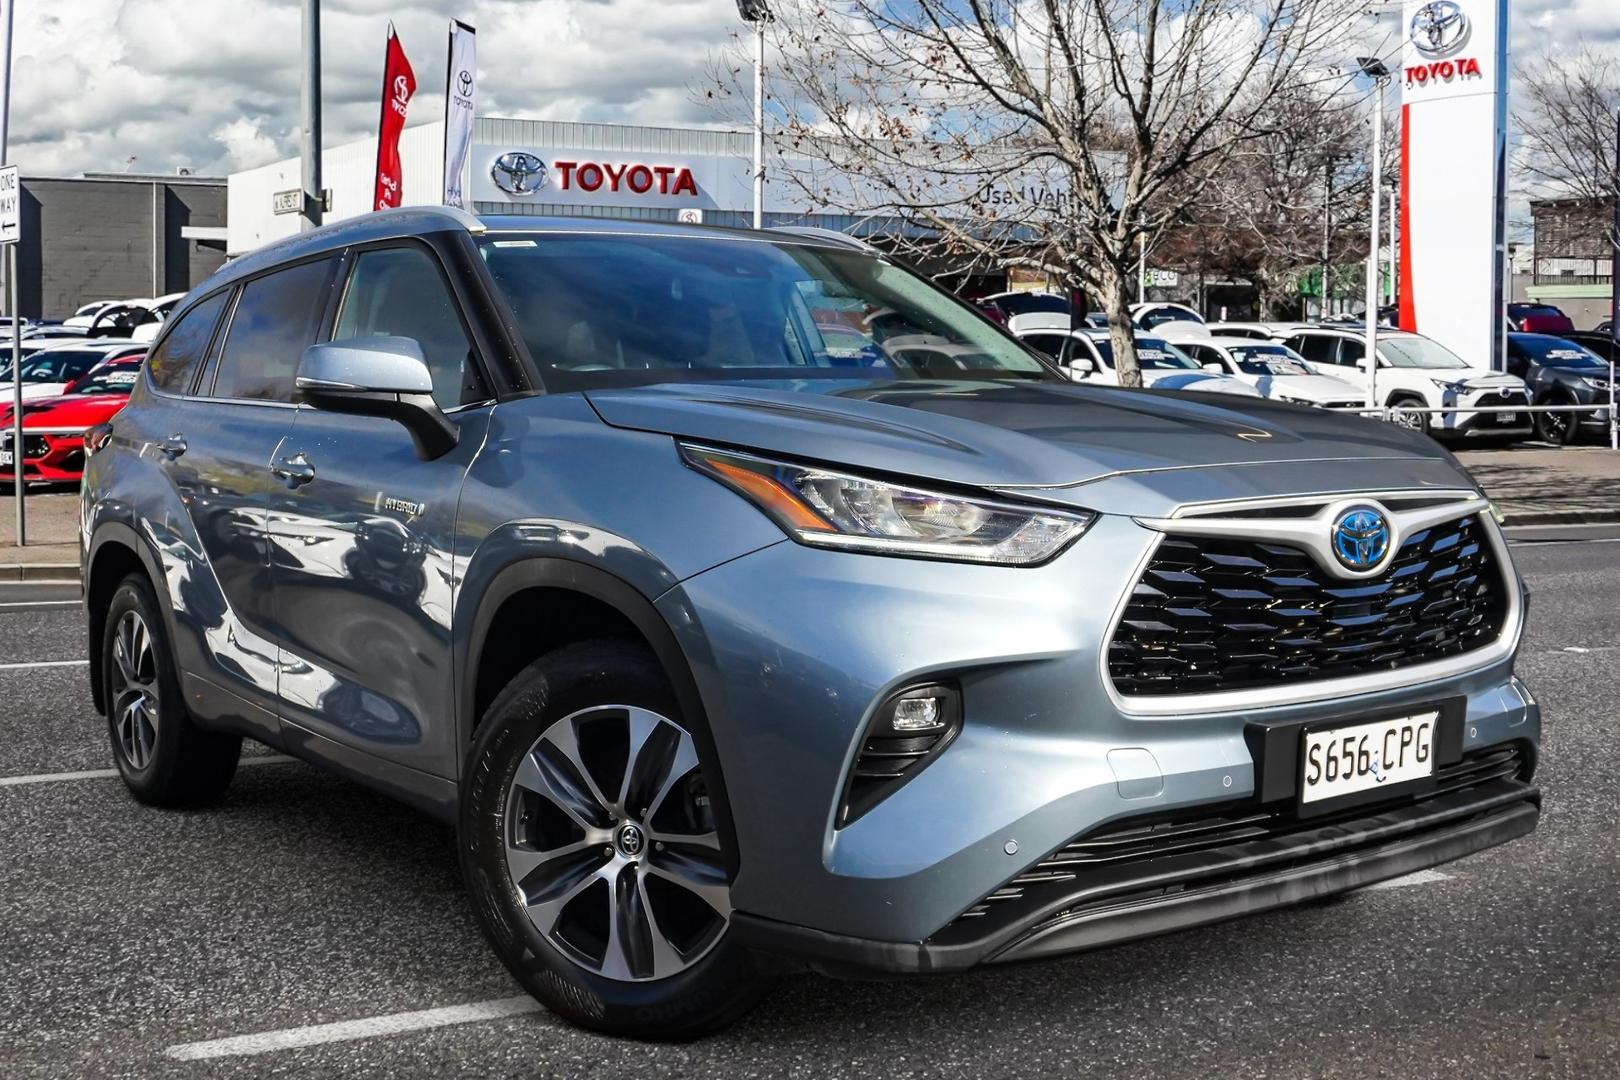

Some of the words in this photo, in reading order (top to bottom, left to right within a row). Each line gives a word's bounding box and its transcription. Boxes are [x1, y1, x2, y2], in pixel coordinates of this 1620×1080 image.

[1404, 58, 1481, 83] TOYOTA
[1, 172, 15, 192] ONE
[555, 161, 698, 196] TOYOTA
